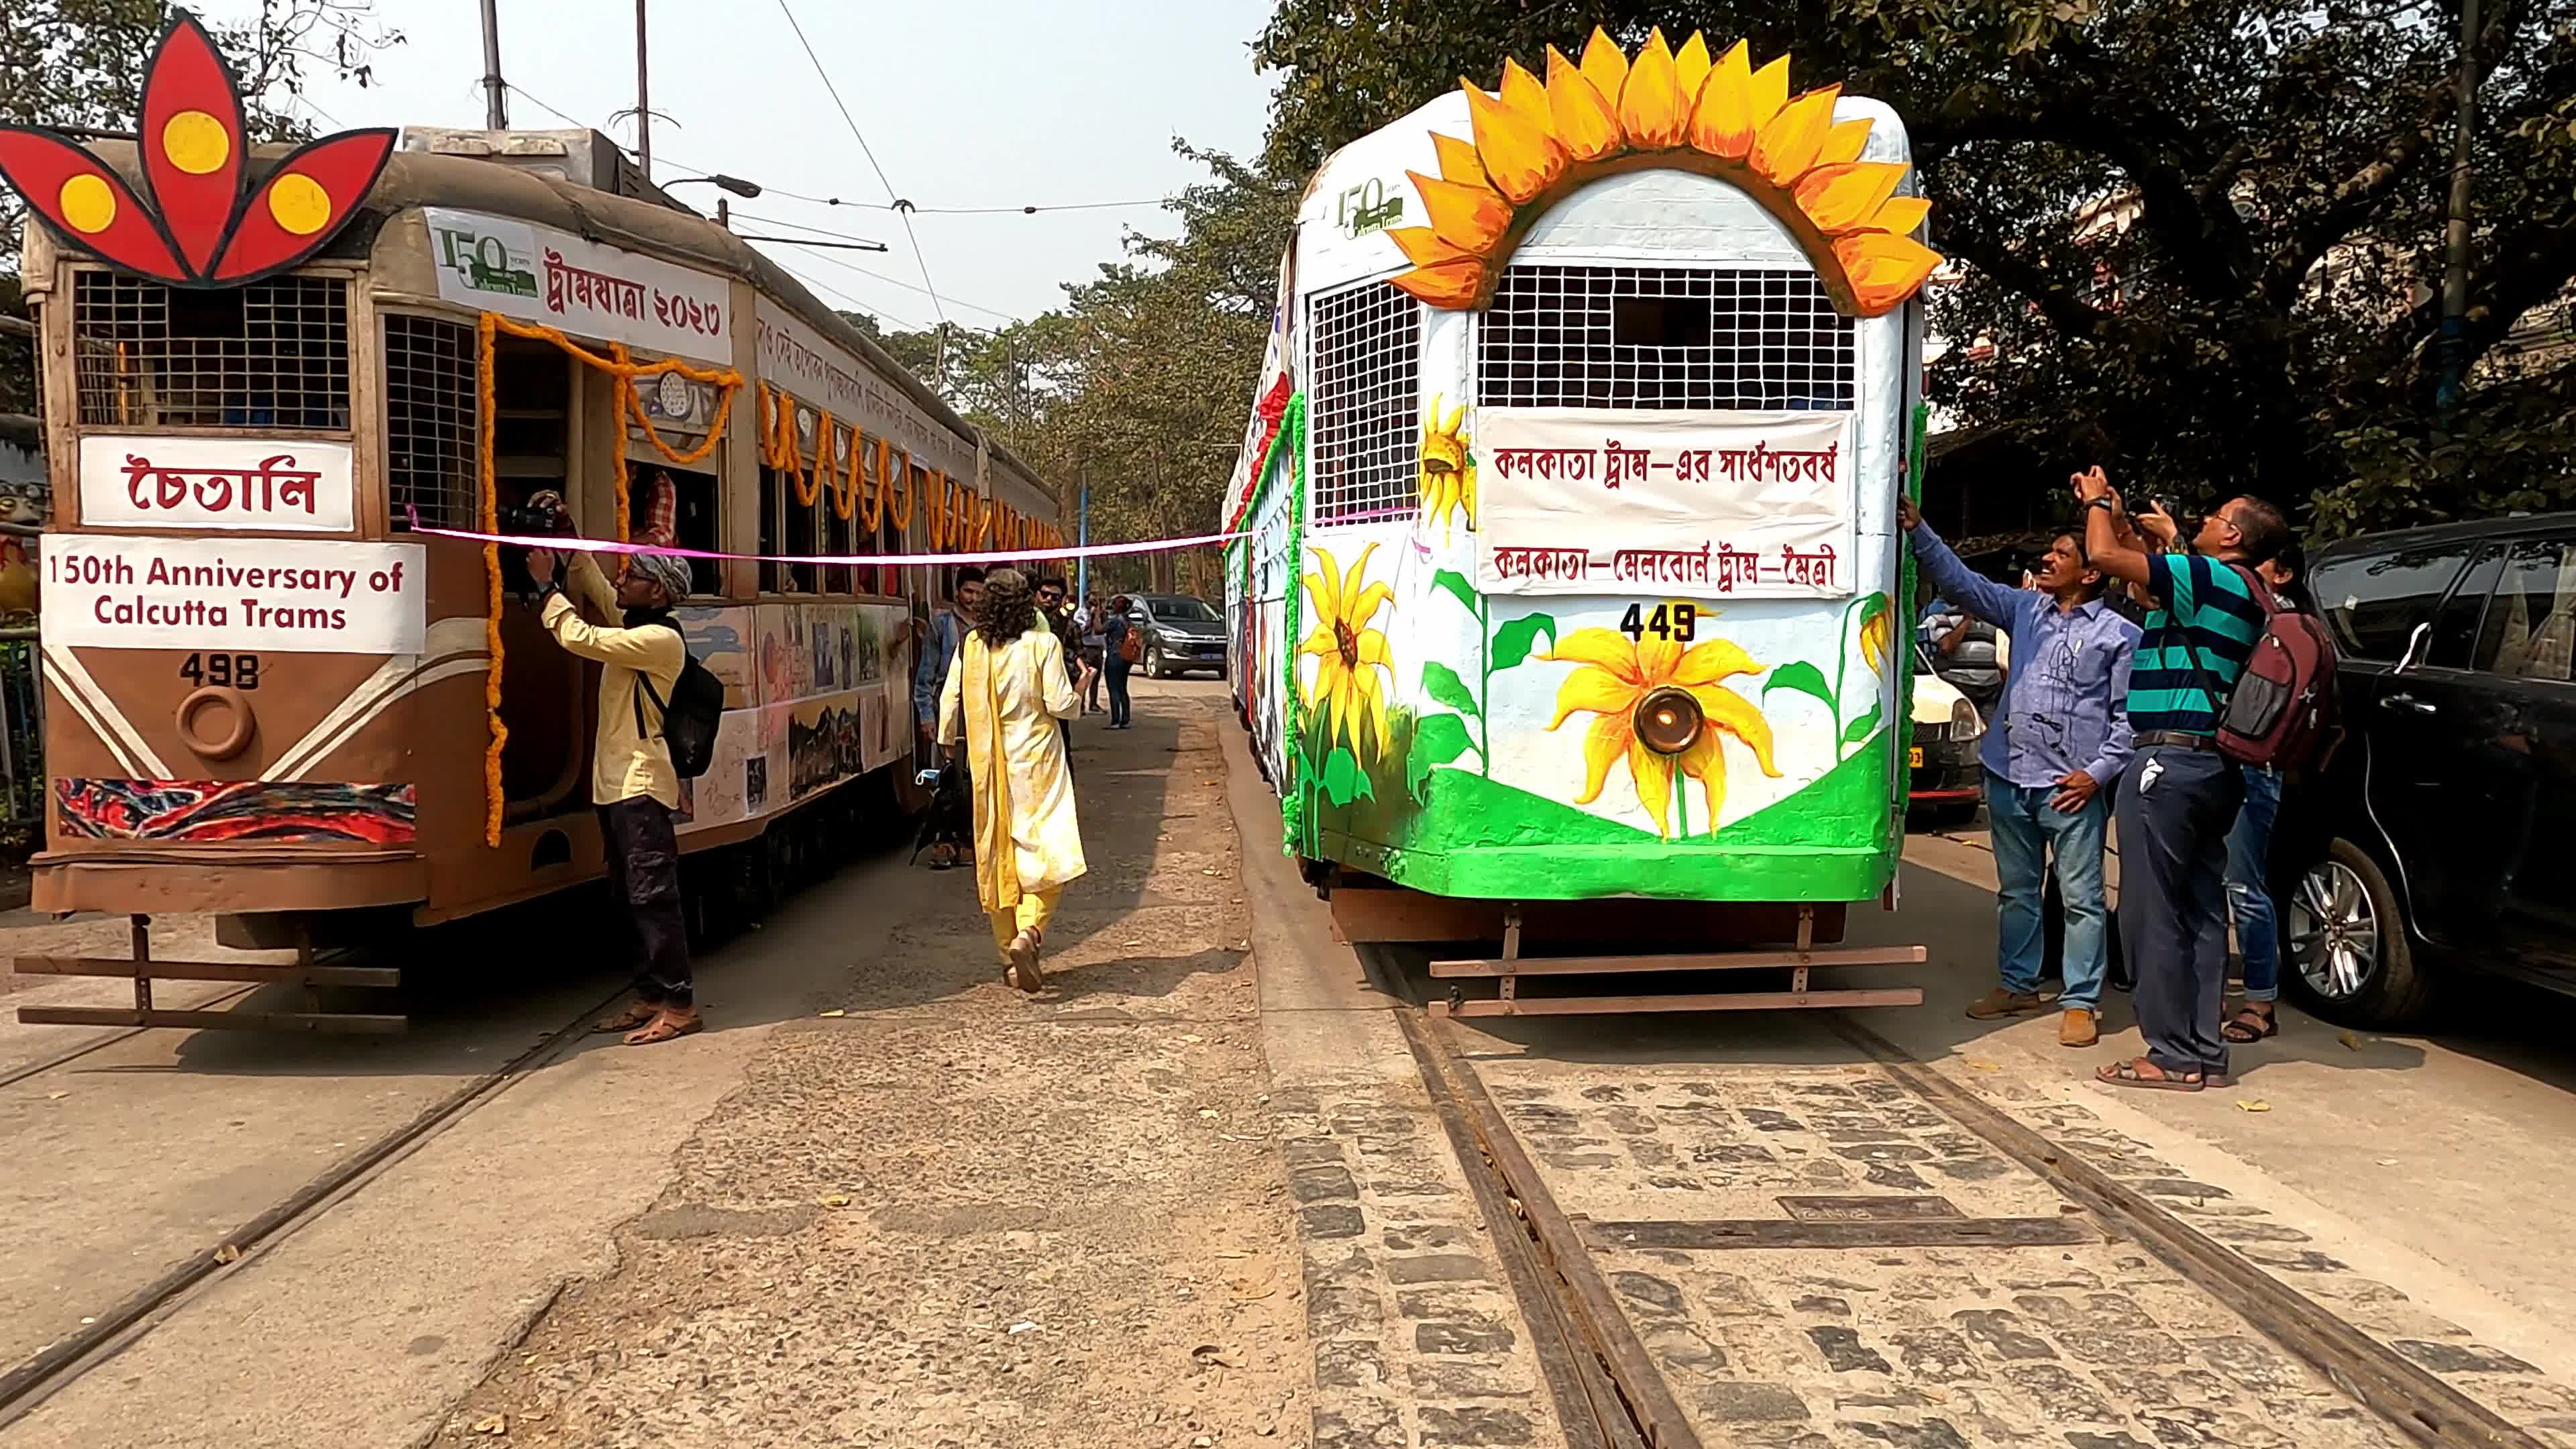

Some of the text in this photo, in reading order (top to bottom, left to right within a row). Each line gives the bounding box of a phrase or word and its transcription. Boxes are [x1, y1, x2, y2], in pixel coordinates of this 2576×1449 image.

[433, 227, 507, 289] 150
[543, 247, 720, 336] ট্রামযাত্রা ২০২৩
[120, 453, 322, 515] চৈতালি
[1493, 448, 1597, 481] কলকাতা
[50, 555, 403, 599] 150th Anniversary of
[95, 595, 347, 630] Calcutta Trams
[1620, 603, 1696, 642] 449
[180, 652, 259, 690] 498
